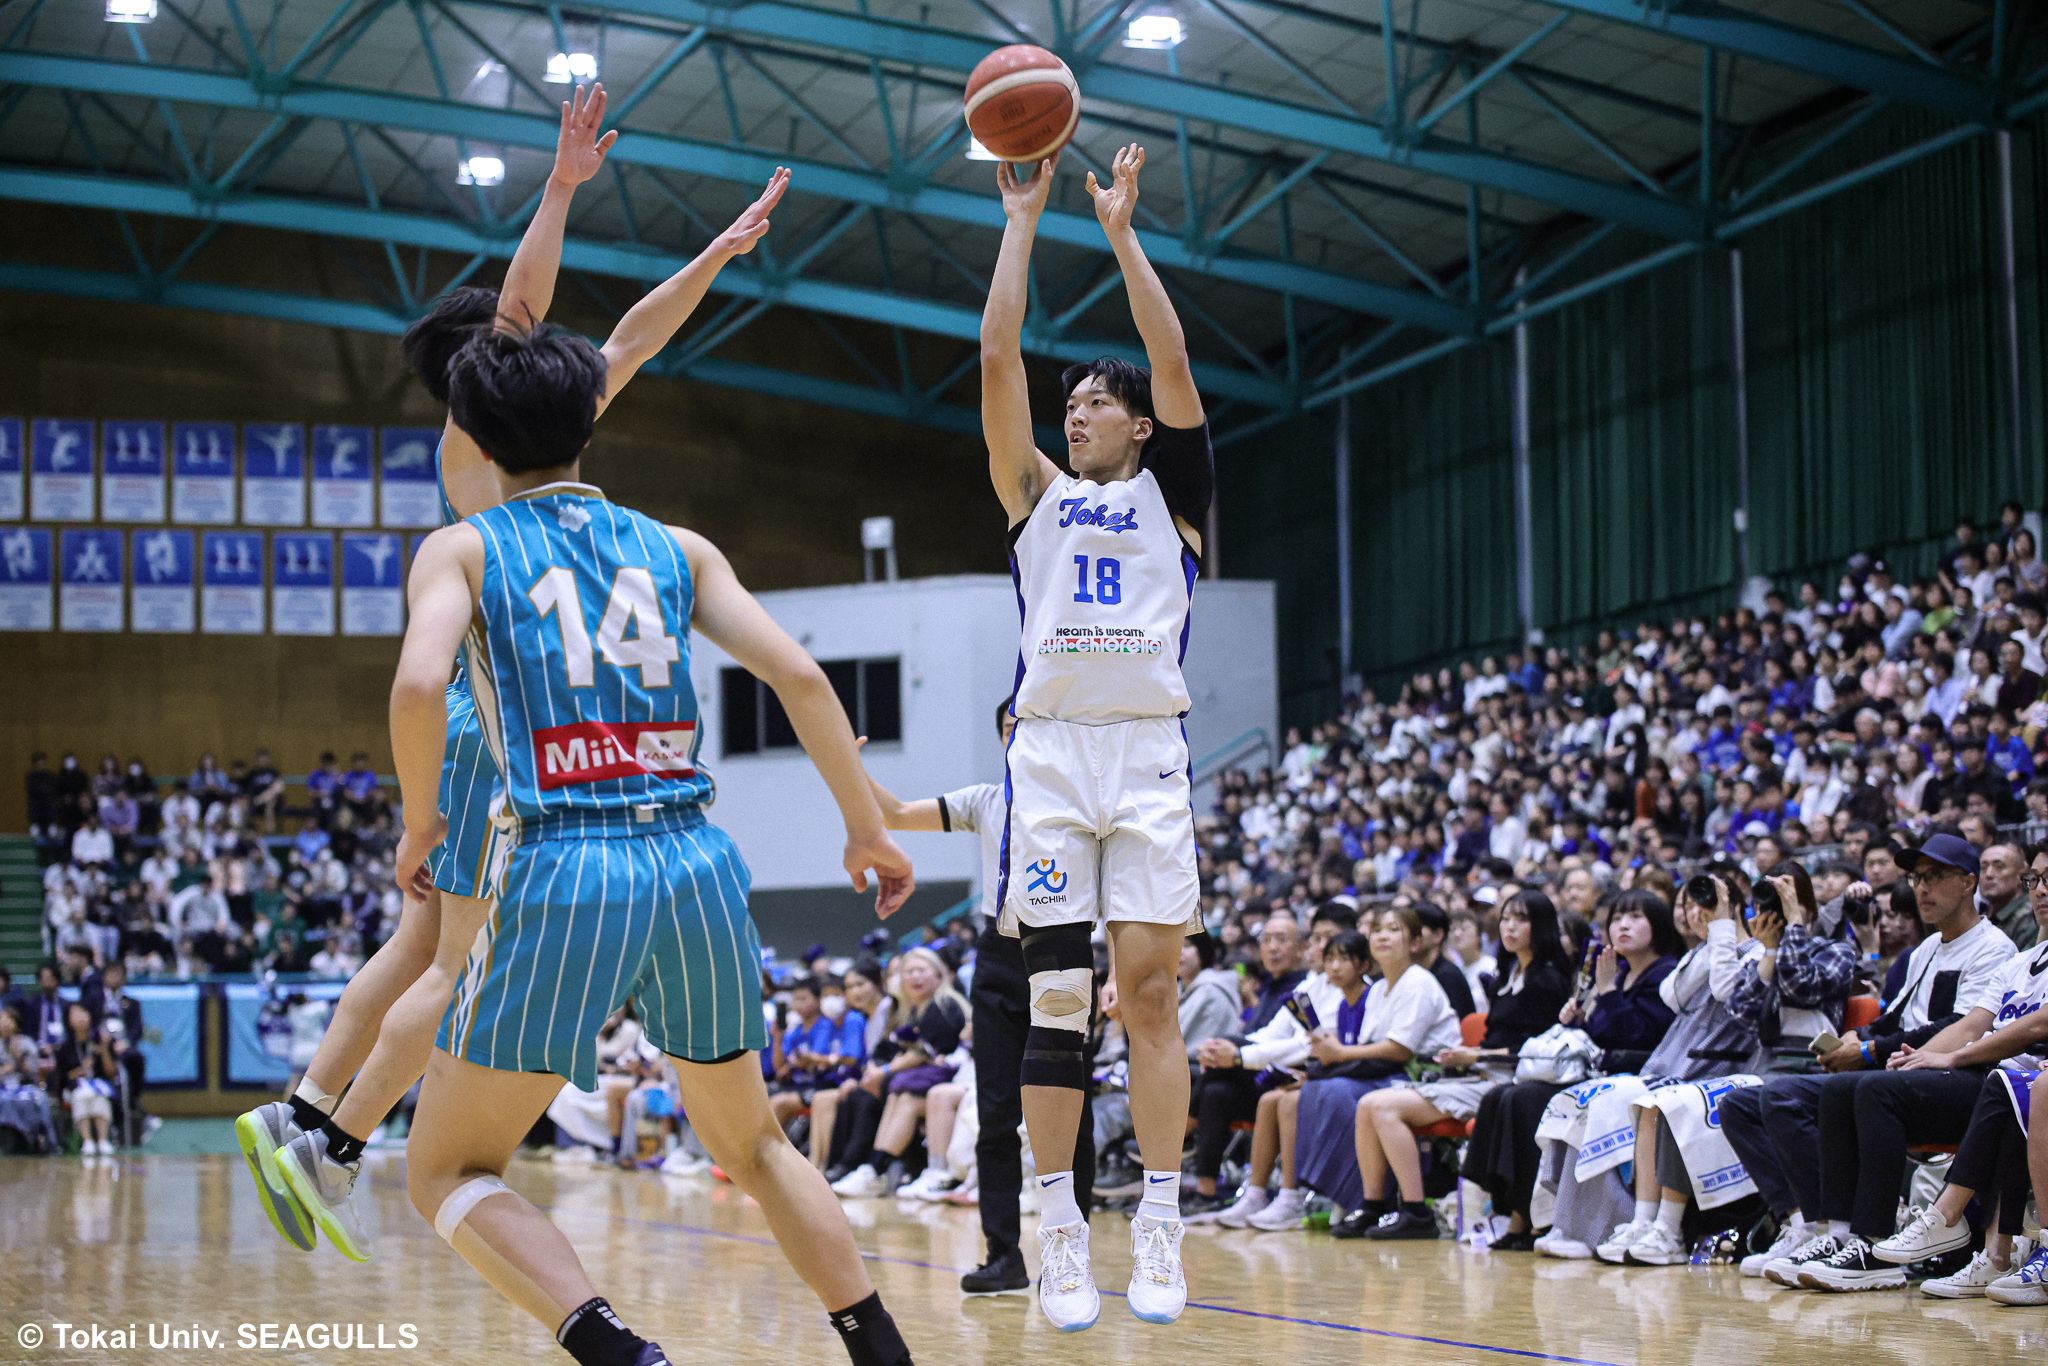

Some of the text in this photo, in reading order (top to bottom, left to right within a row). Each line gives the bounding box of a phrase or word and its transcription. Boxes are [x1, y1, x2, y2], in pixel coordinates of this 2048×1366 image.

[1059, 496, 1139, 534] Tokai
[1073, 554, 1122, 605] 18
[528, 566, 680, 688] 14
[1095, 625, 1104, 636] is
[1029, 895, 1067, 905] TACHIHI
